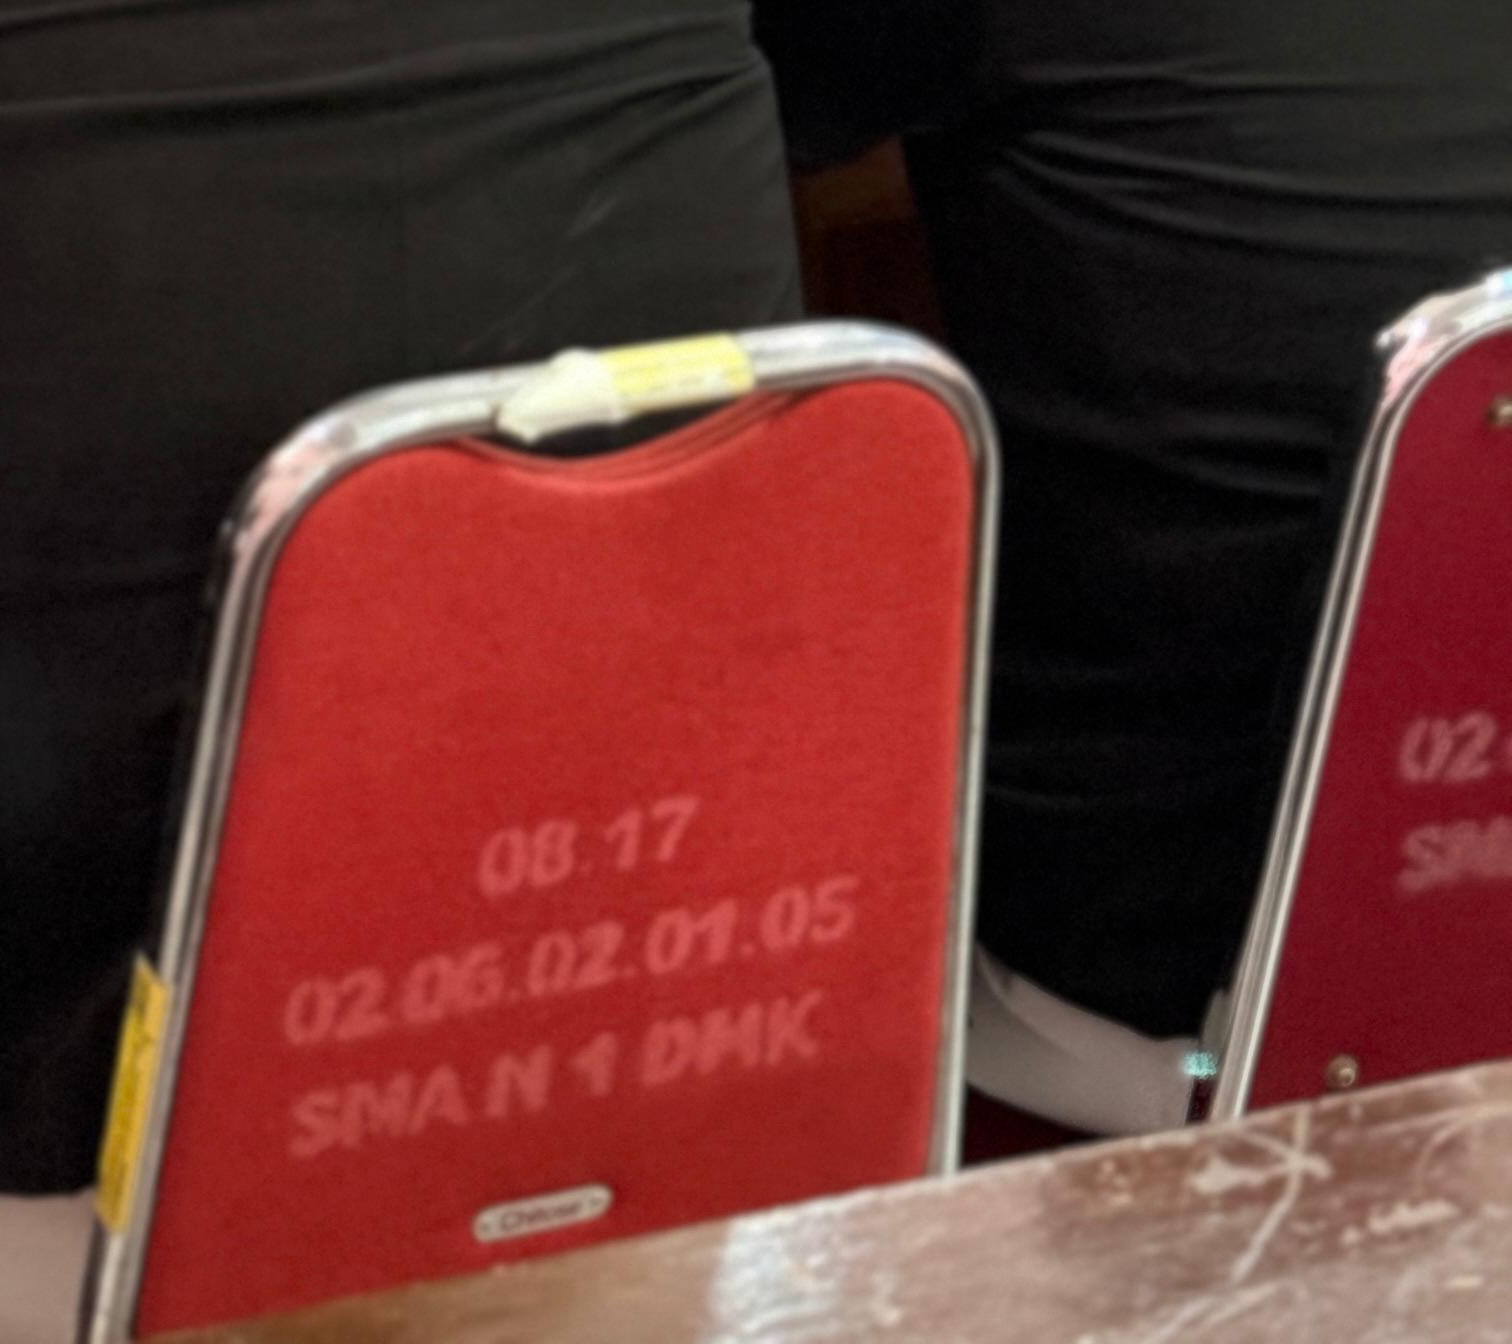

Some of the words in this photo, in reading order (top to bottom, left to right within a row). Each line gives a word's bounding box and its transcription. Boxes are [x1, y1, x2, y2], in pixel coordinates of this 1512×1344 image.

[288, 1064, 469, 1160] SMA
[485, 1042, 553, 1119] N
[575, 1030, 619, 1097] 1
[640, 988, 825, 1088] DMK
